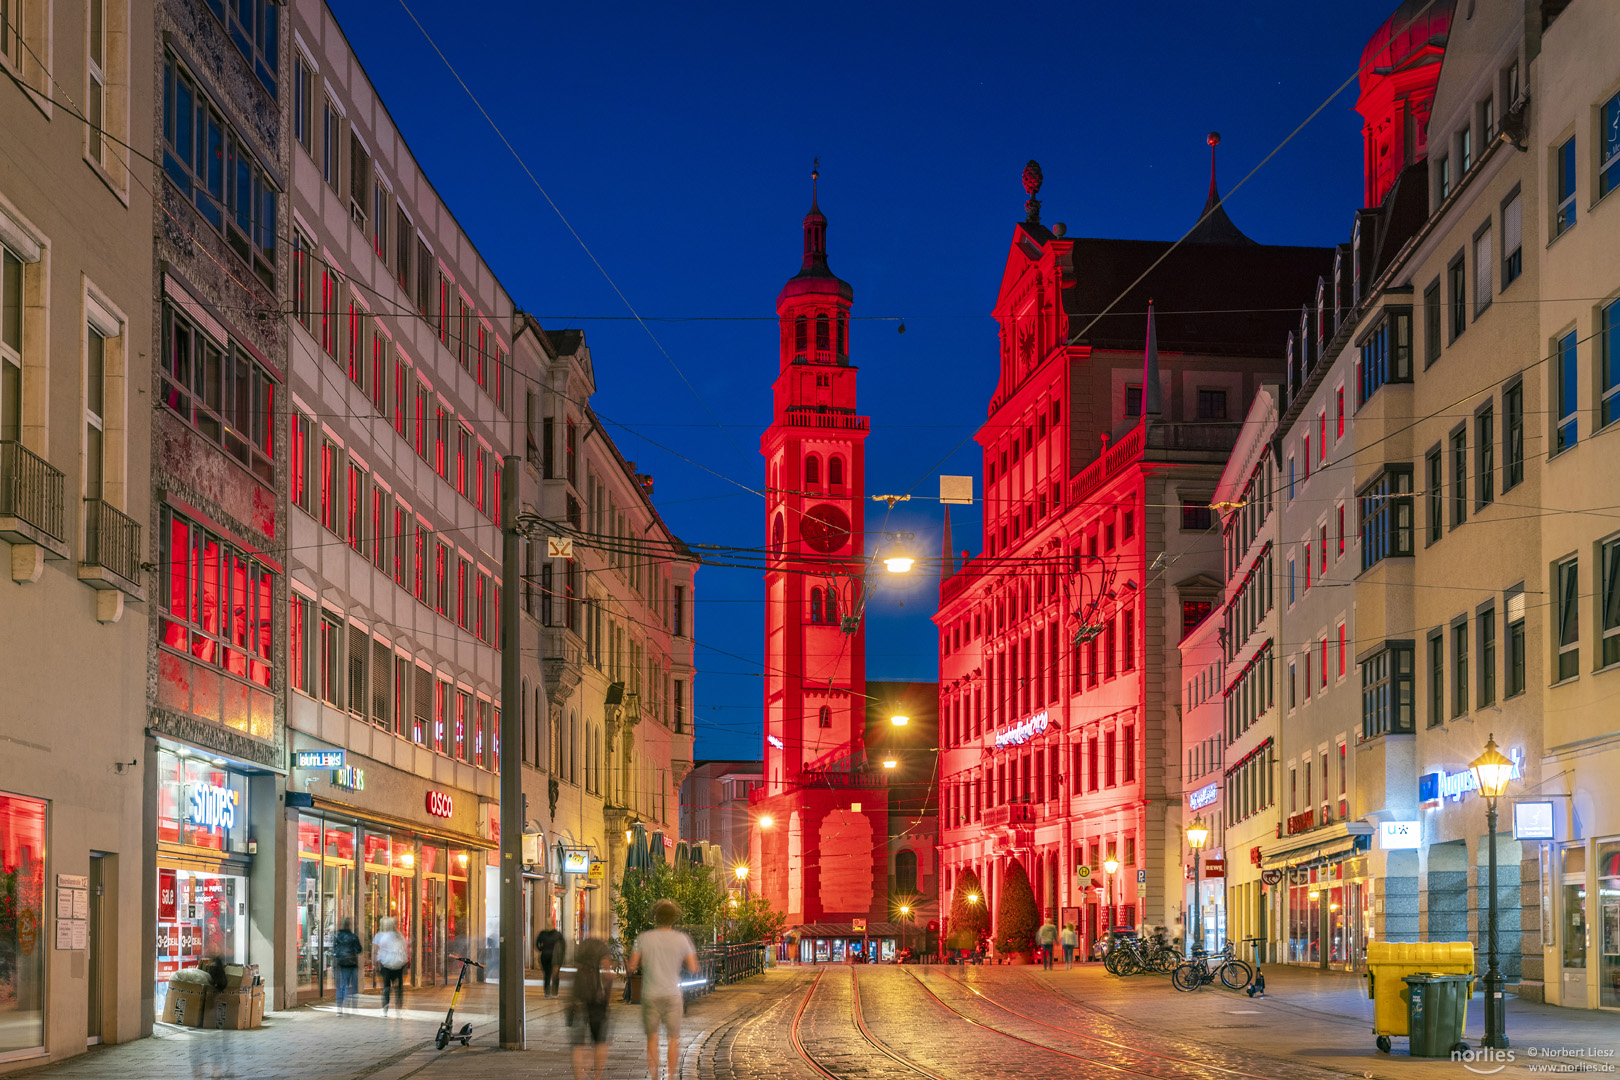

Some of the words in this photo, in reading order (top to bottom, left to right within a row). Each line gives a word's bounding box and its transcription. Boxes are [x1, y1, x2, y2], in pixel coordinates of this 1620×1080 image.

[299, 753, 342, 767] BUTLERS
[194, 782, 234, 834] snipes
[431, 790, 453, 818] OSCO
[1206, 864, 1224, 873] REWE
[162, 889, 174, 905] sale
